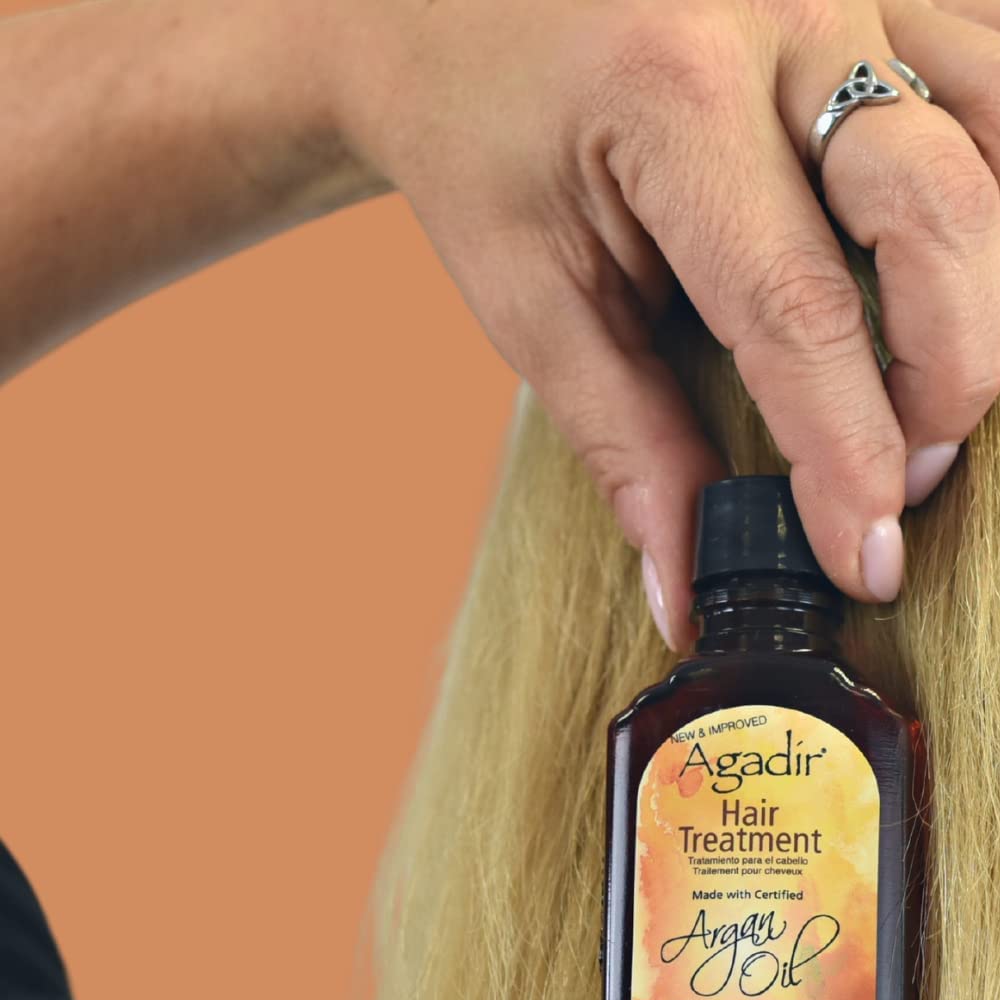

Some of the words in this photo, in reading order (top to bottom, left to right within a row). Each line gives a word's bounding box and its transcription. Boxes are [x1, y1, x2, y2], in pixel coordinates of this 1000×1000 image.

[671, 730, 696, 744] NEW
[698, 728, 705, 737] &
[709, 715, 767, 735] IMPROVED
[722, 799, 779, 827] Hair
[678, 826, 822, 854] Treatment
[688, 857, 739, 865] Tratamiento
[742, 857, 763, 866] para
[765, 857, 773, 865] el
[776, 857, 808, 865] cabello
[693, 867, 739, 875] Traitement
[741, 868, 761, 877] pour
[764, 867, 802, 875] cheveux
[692, 890, 723, 900] Made
[727, 890, 751, 899] with
[755, 890, 803, 900] Certified
[661, 909, 787, 997] Argan
[739, 914, 840, 997] Oil
